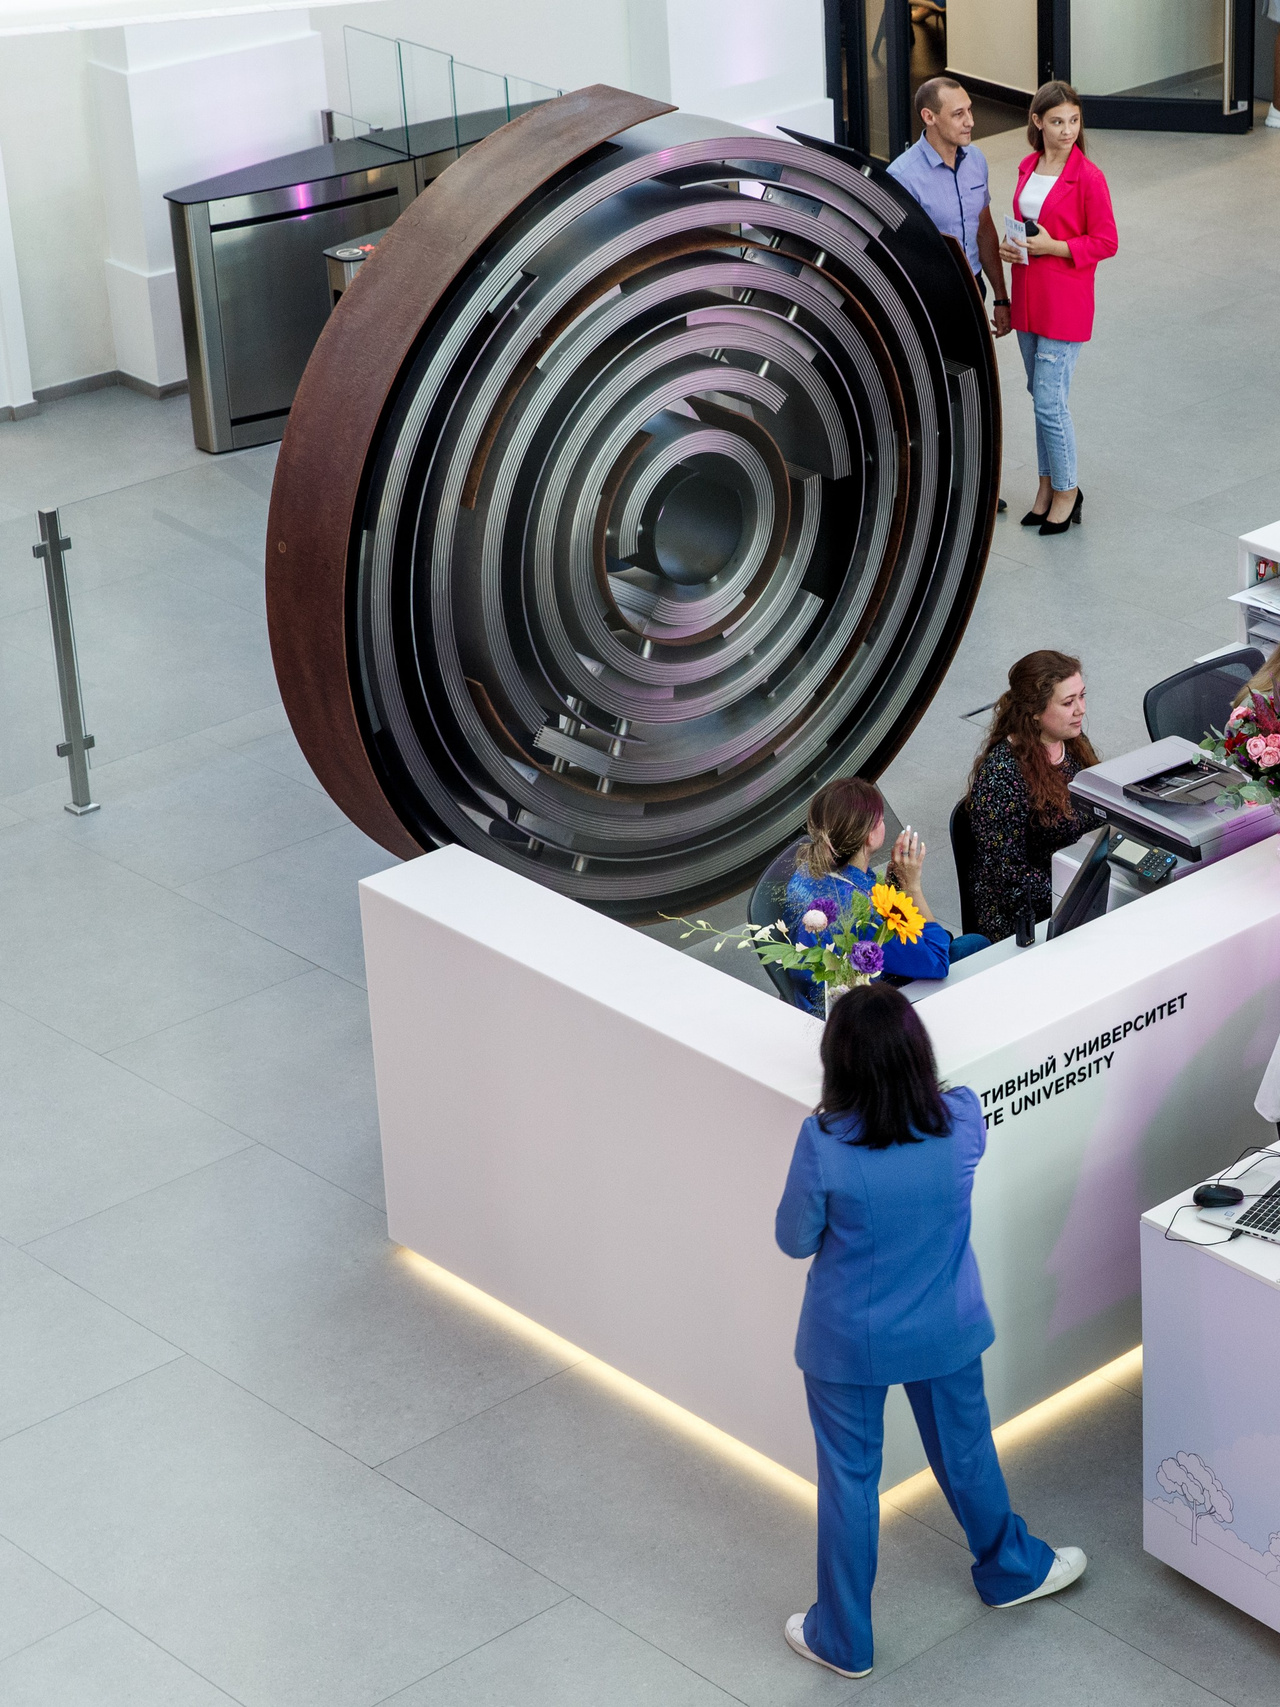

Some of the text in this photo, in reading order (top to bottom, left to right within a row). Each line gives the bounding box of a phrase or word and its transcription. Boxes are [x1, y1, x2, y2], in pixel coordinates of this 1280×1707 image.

[980, 992, 1189, 1108] ТИВНЫЙ УНИВЕРСИТЕТ
[984, 1051, 1116, 1130] TE UNIVERSITY
